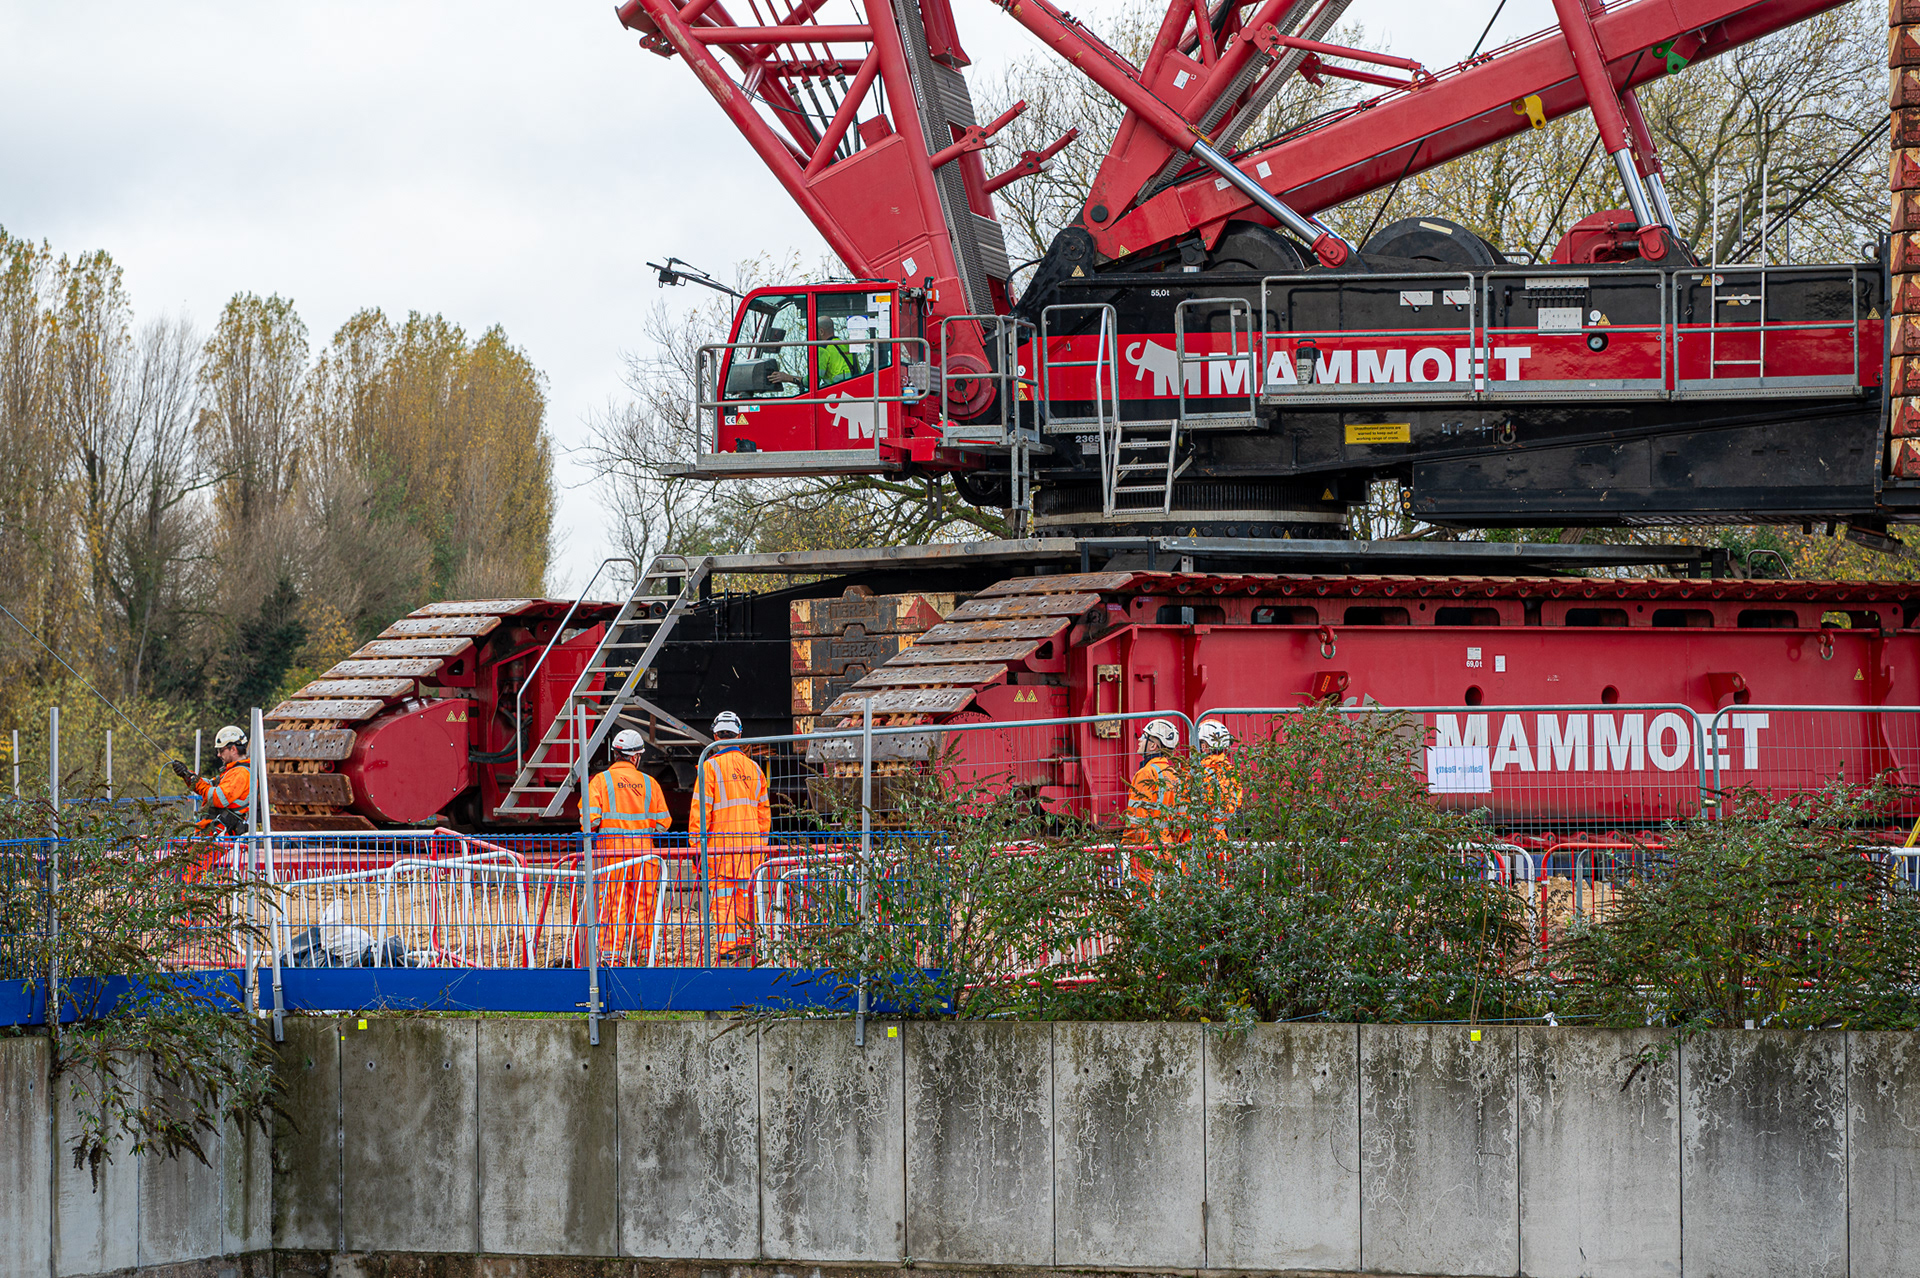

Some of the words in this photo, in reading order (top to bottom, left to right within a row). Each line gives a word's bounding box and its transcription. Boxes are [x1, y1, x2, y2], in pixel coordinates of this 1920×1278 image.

[1208, 346, 1531, 394] MAMMOET
[1075, 435, 1100, 443] 2365
[832, 602, 876, 618] TEREX
[832, 642, 878, 657] TEREX
[1435, 712, 1769, 772] MAMMOET
[732, 773, 752, 781] Bton
